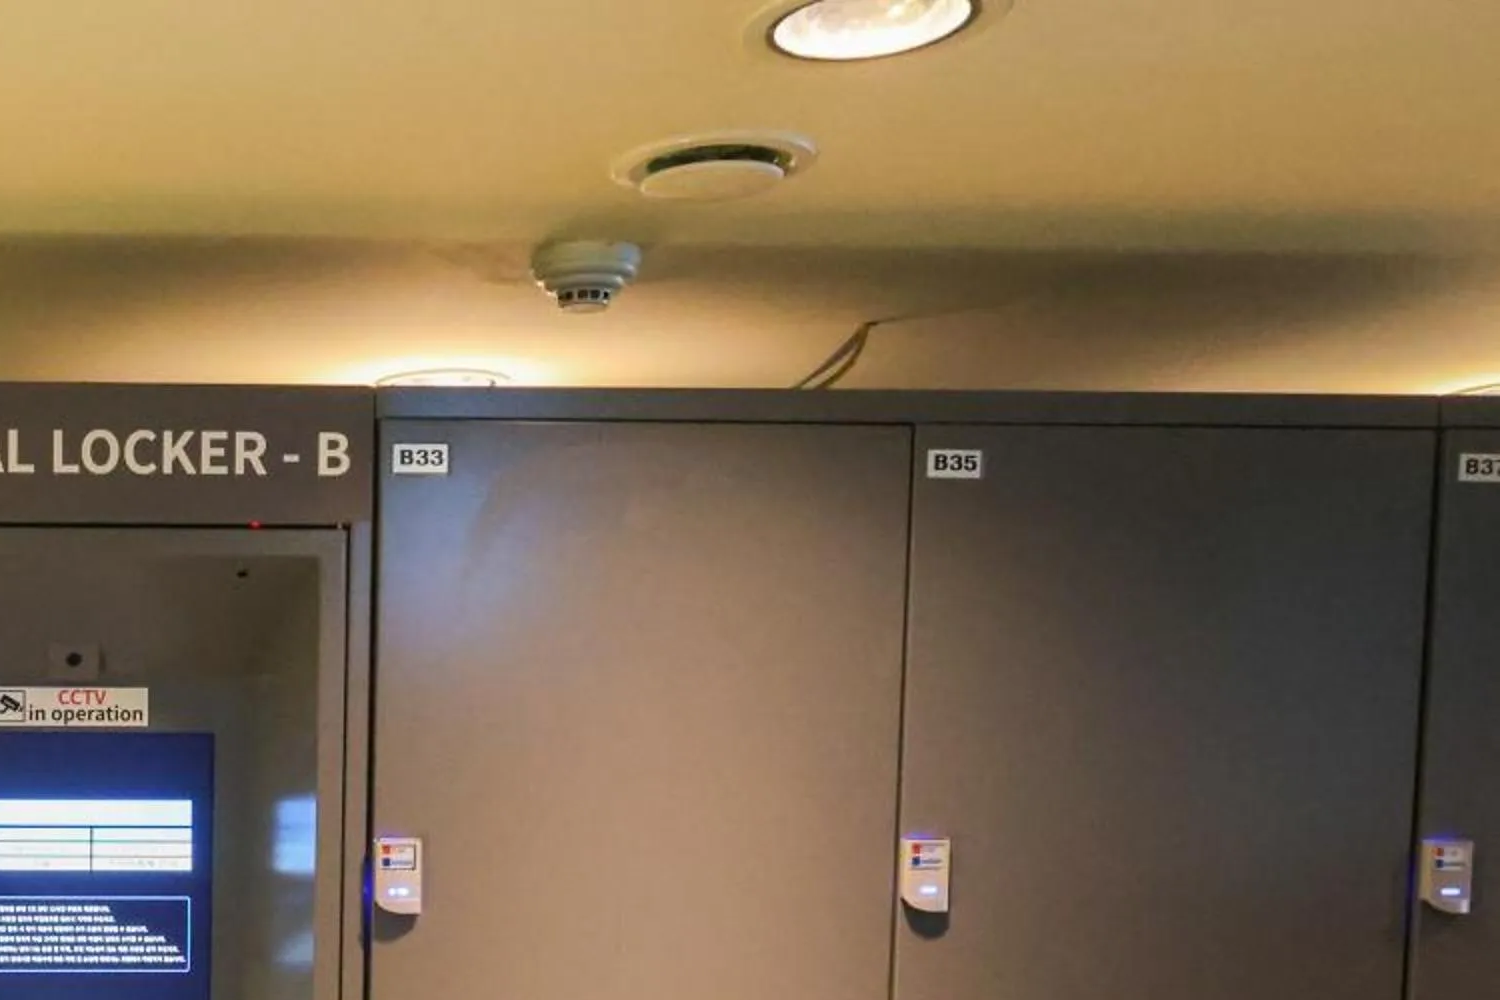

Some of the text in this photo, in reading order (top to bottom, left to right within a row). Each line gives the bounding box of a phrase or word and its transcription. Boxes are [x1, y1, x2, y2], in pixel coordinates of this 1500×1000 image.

[53, 429, 268, 476] LOCKER
[317, 432, 351, 477] B
[400, 449, 443, 467] B33
[934, 454, 978, 472] B35
[58, 689, 107, 705] CCTV
[29, 704, 144, 725] in operation
